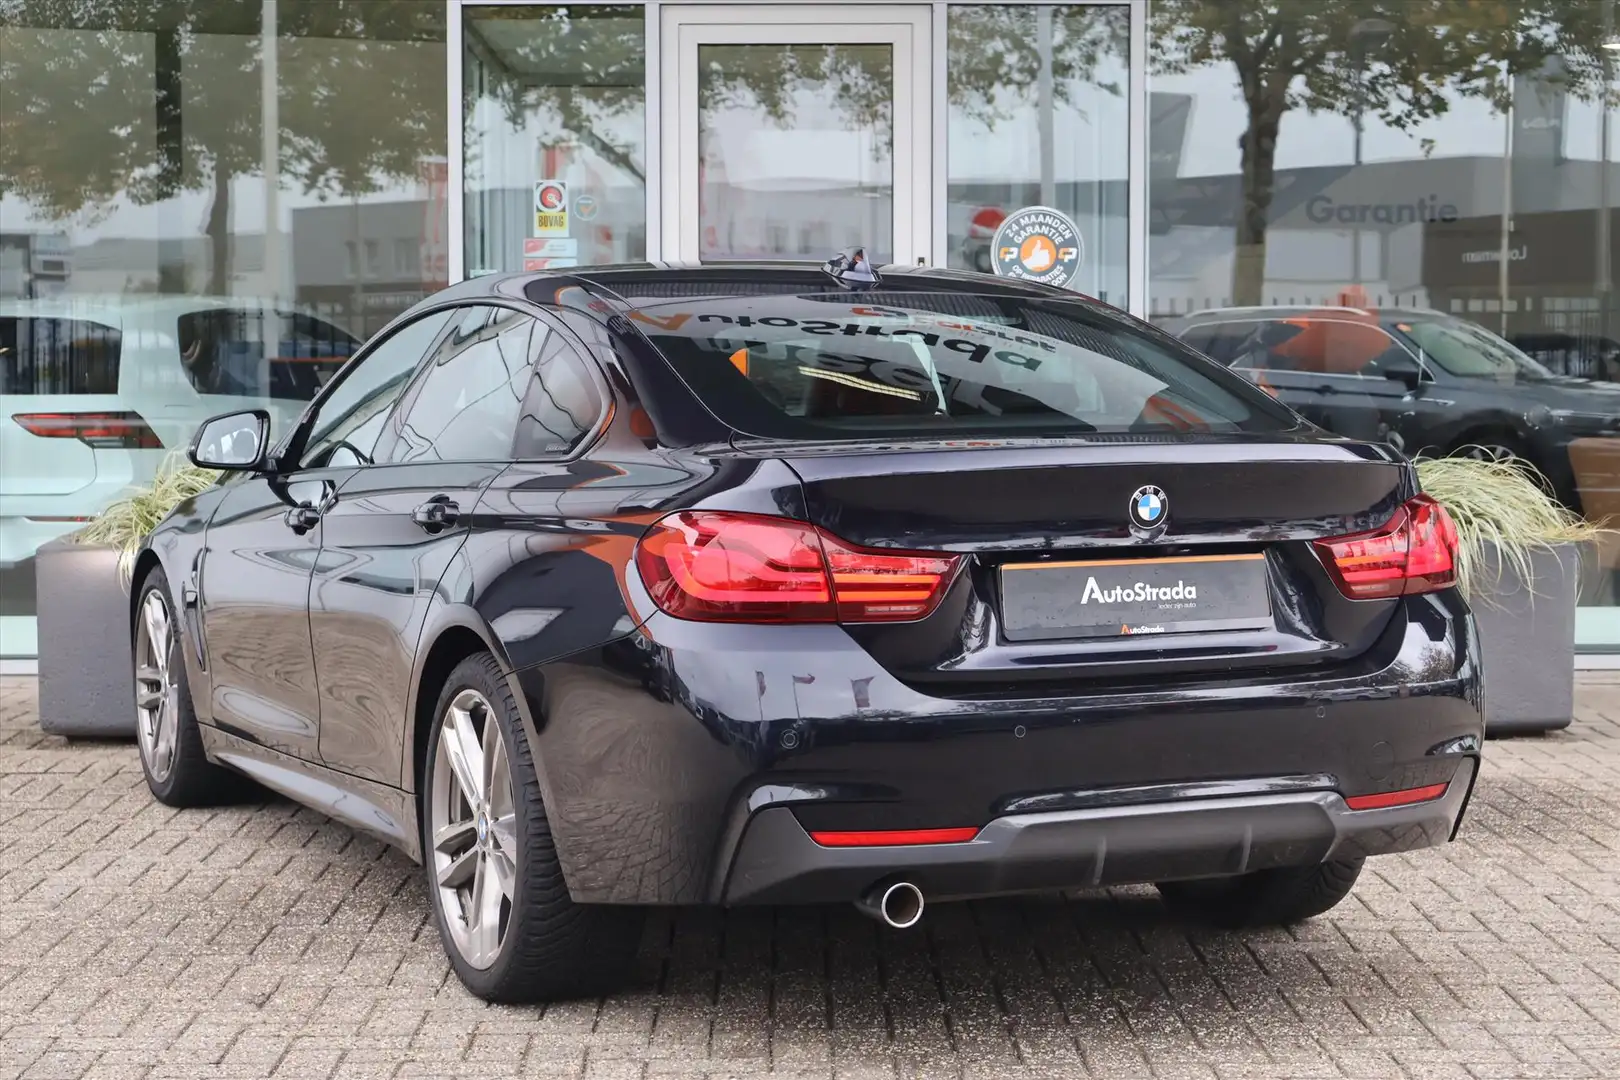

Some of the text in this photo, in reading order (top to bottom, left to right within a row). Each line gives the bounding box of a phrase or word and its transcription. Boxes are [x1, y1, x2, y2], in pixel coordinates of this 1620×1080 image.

[1305, 194, 1459, 224] Garantie
[538, 215, 564, 227] BOVAG
[1005, 214, 1073, 239] 24 MAANDEN
[1013, 225, 1064, 245] GARANTIE
[1080, 576, 1197, 605] AutoStrada
[1121, 623, 1165, 635] AutoStrada
